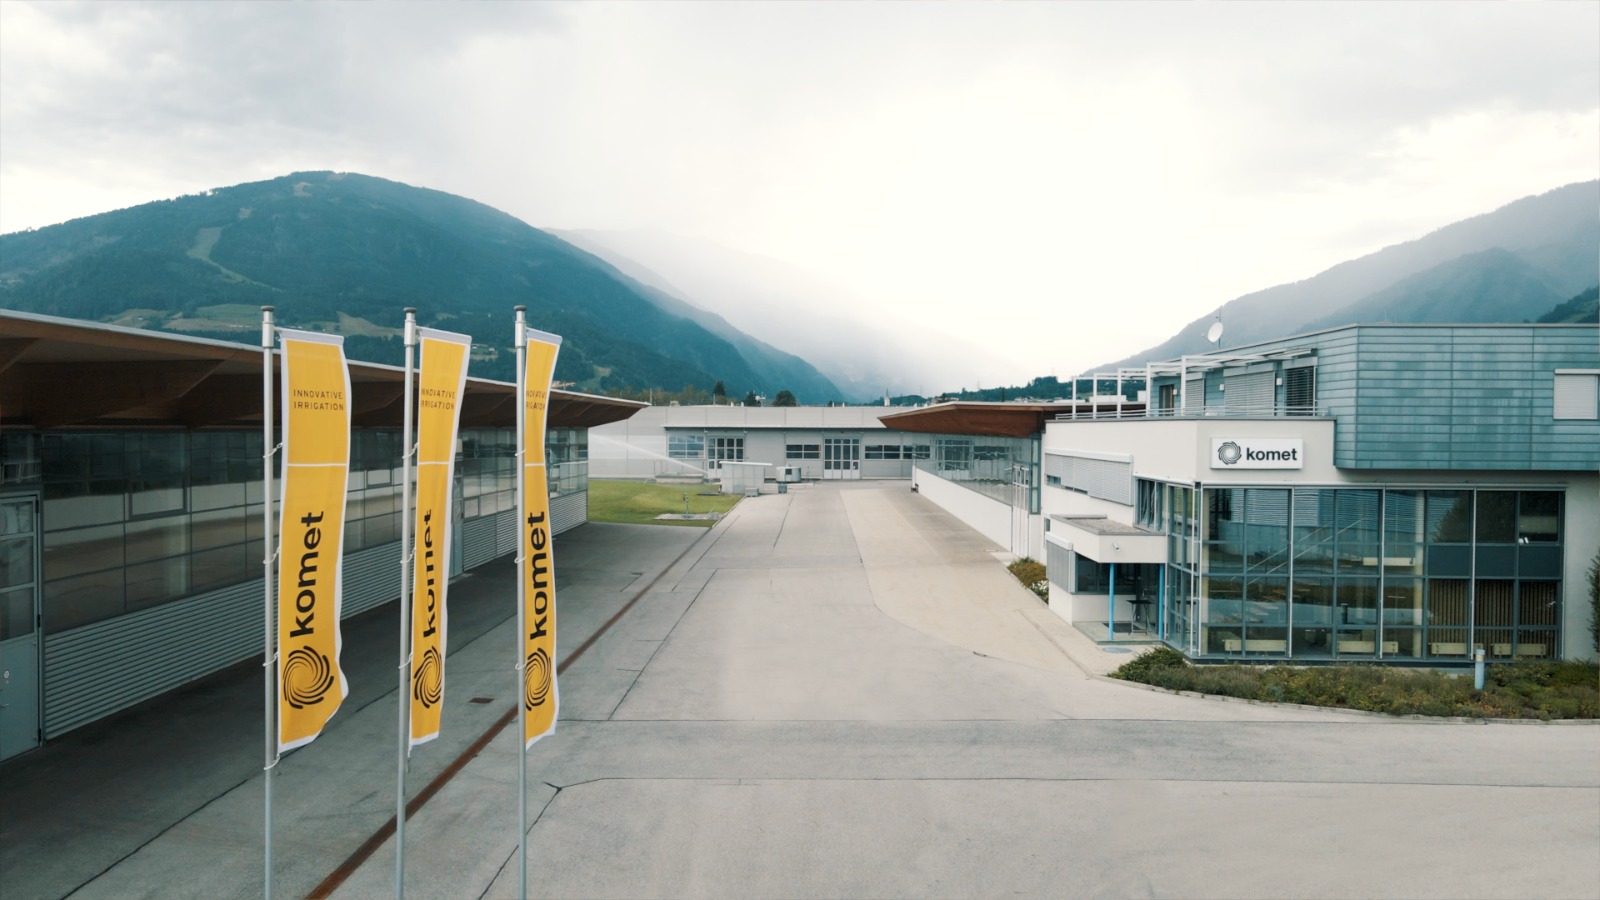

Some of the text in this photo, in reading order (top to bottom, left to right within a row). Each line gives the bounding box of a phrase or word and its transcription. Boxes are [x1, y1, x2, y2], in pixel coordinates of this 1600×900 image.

[293, 389, 343, 399] INNOVATIVE
[294, 401, 344, 411] IRRIGATION
[1246, 447, 1298, 461] komet
[289, 510, 324, 638] komet
[527, 511, 548, 640] komet
